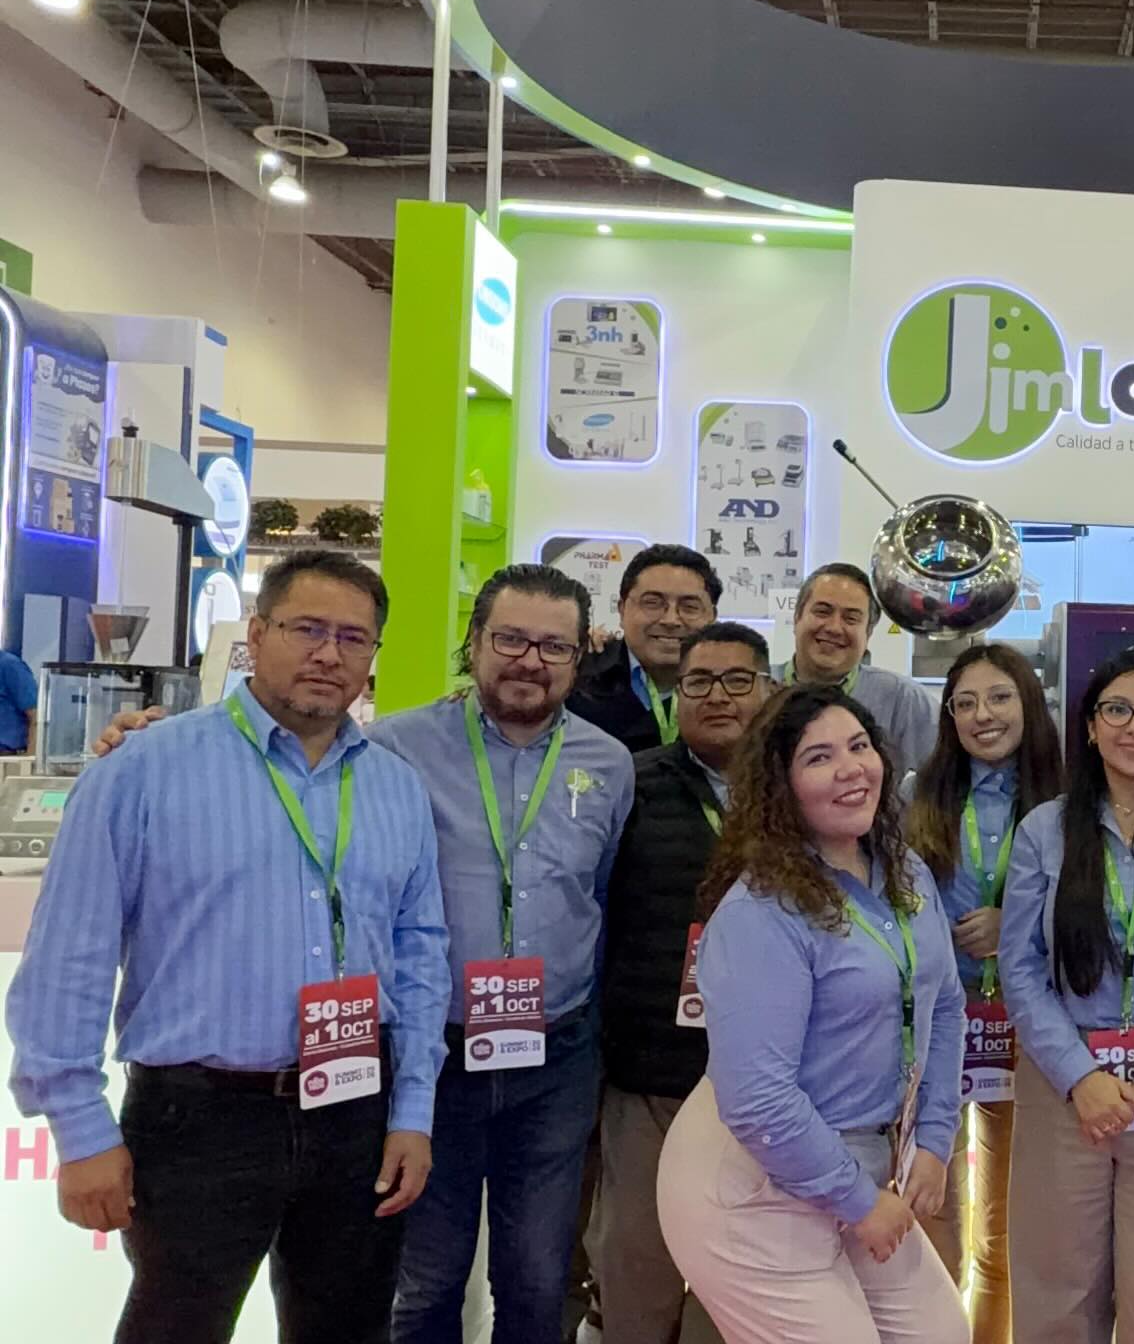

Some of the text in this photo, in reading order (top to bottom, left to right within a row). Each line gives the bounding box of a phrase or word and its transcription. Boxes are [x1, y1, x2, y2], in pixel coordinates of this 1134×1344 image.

[586, 325, 624, 343] 3nh
[1056, 433, 1111, 451] Calidad
[1116, 440, 1124, 451] a
[718, 498, 780, 518] AND
[588, 561, 609, 569] TEST
[470, 976, 540, 995] 30 SEP
[303, 998, 374, 1023] 30 SEP
[470, 995, 541, 1016] al 1 OCT
[304, 1018, 374, 1046] al 1 OCT
[985, 1021, 1012, 1034] SEP
[972, 1035, 983, 1052] 1
[985, 1038, 1012, 1052] OCT
[1095, 1046, 1125, 1065] 30
[342, 1074, 362, 1085] EXPO
